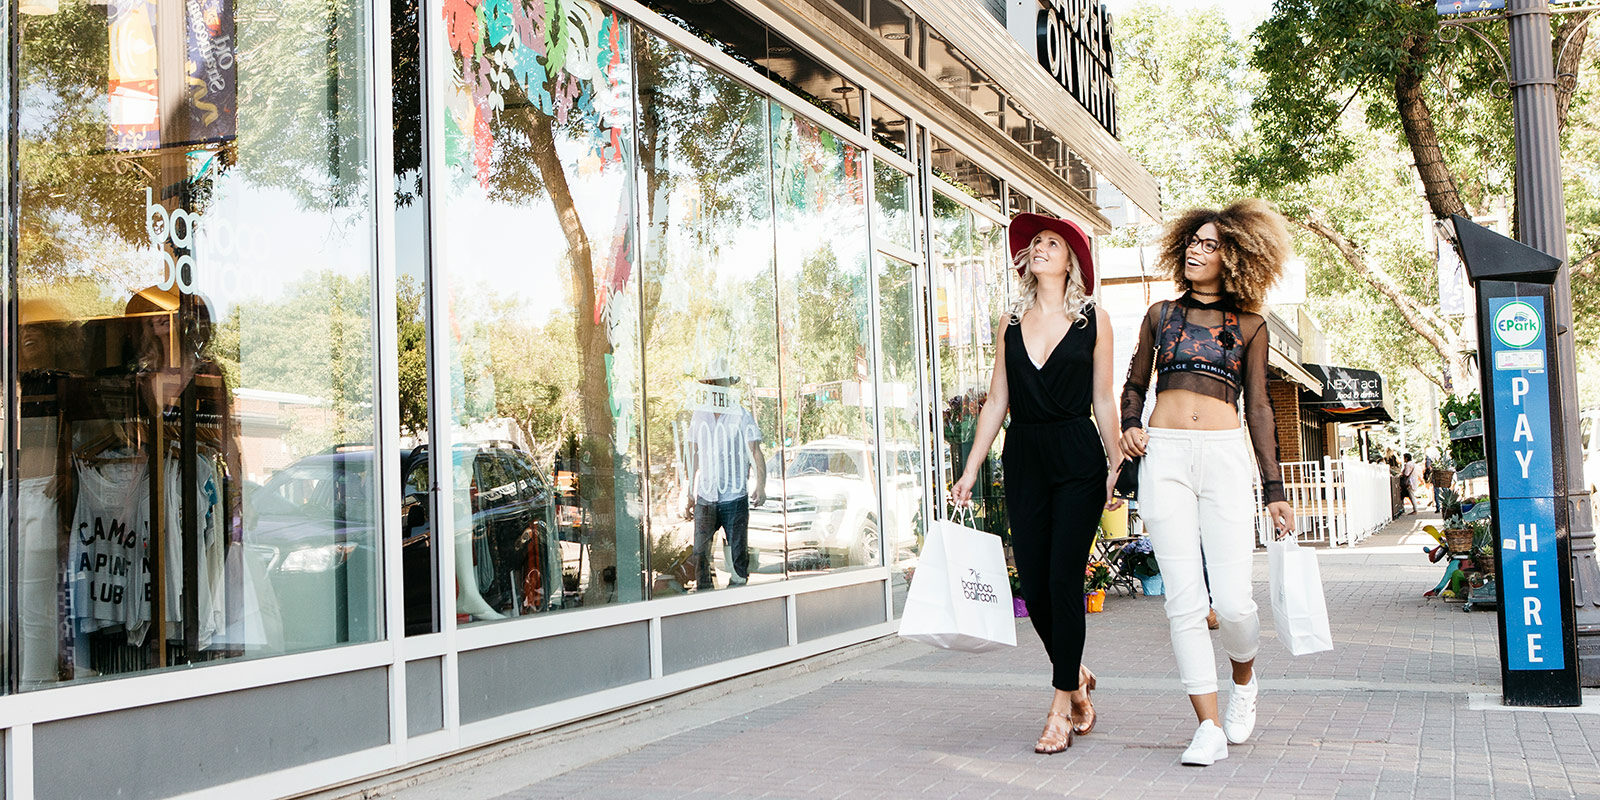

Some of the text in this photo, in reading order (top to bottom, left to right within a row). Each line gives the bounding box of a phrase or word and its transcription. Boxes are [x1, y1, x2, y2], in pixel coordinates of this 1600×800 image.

[1040, 8, 1073, 94] ON
[1498, 319, 1537, 331] EPark
[1194, 363, 1236, 381] CRIMINAL
[1327, 378, 1360, 390] NEXT
[1361, 378, 1378, 389] act
[1335, 391, 1352, 401] food
[1360, 390, 1379, 399] drink
[1511, 376, 1534, 479] PAY
[79, 516, 137, 549] CAMP
[961, 576, 993, 593] bamboo
[1518, 523, 1544, 663] HERE
